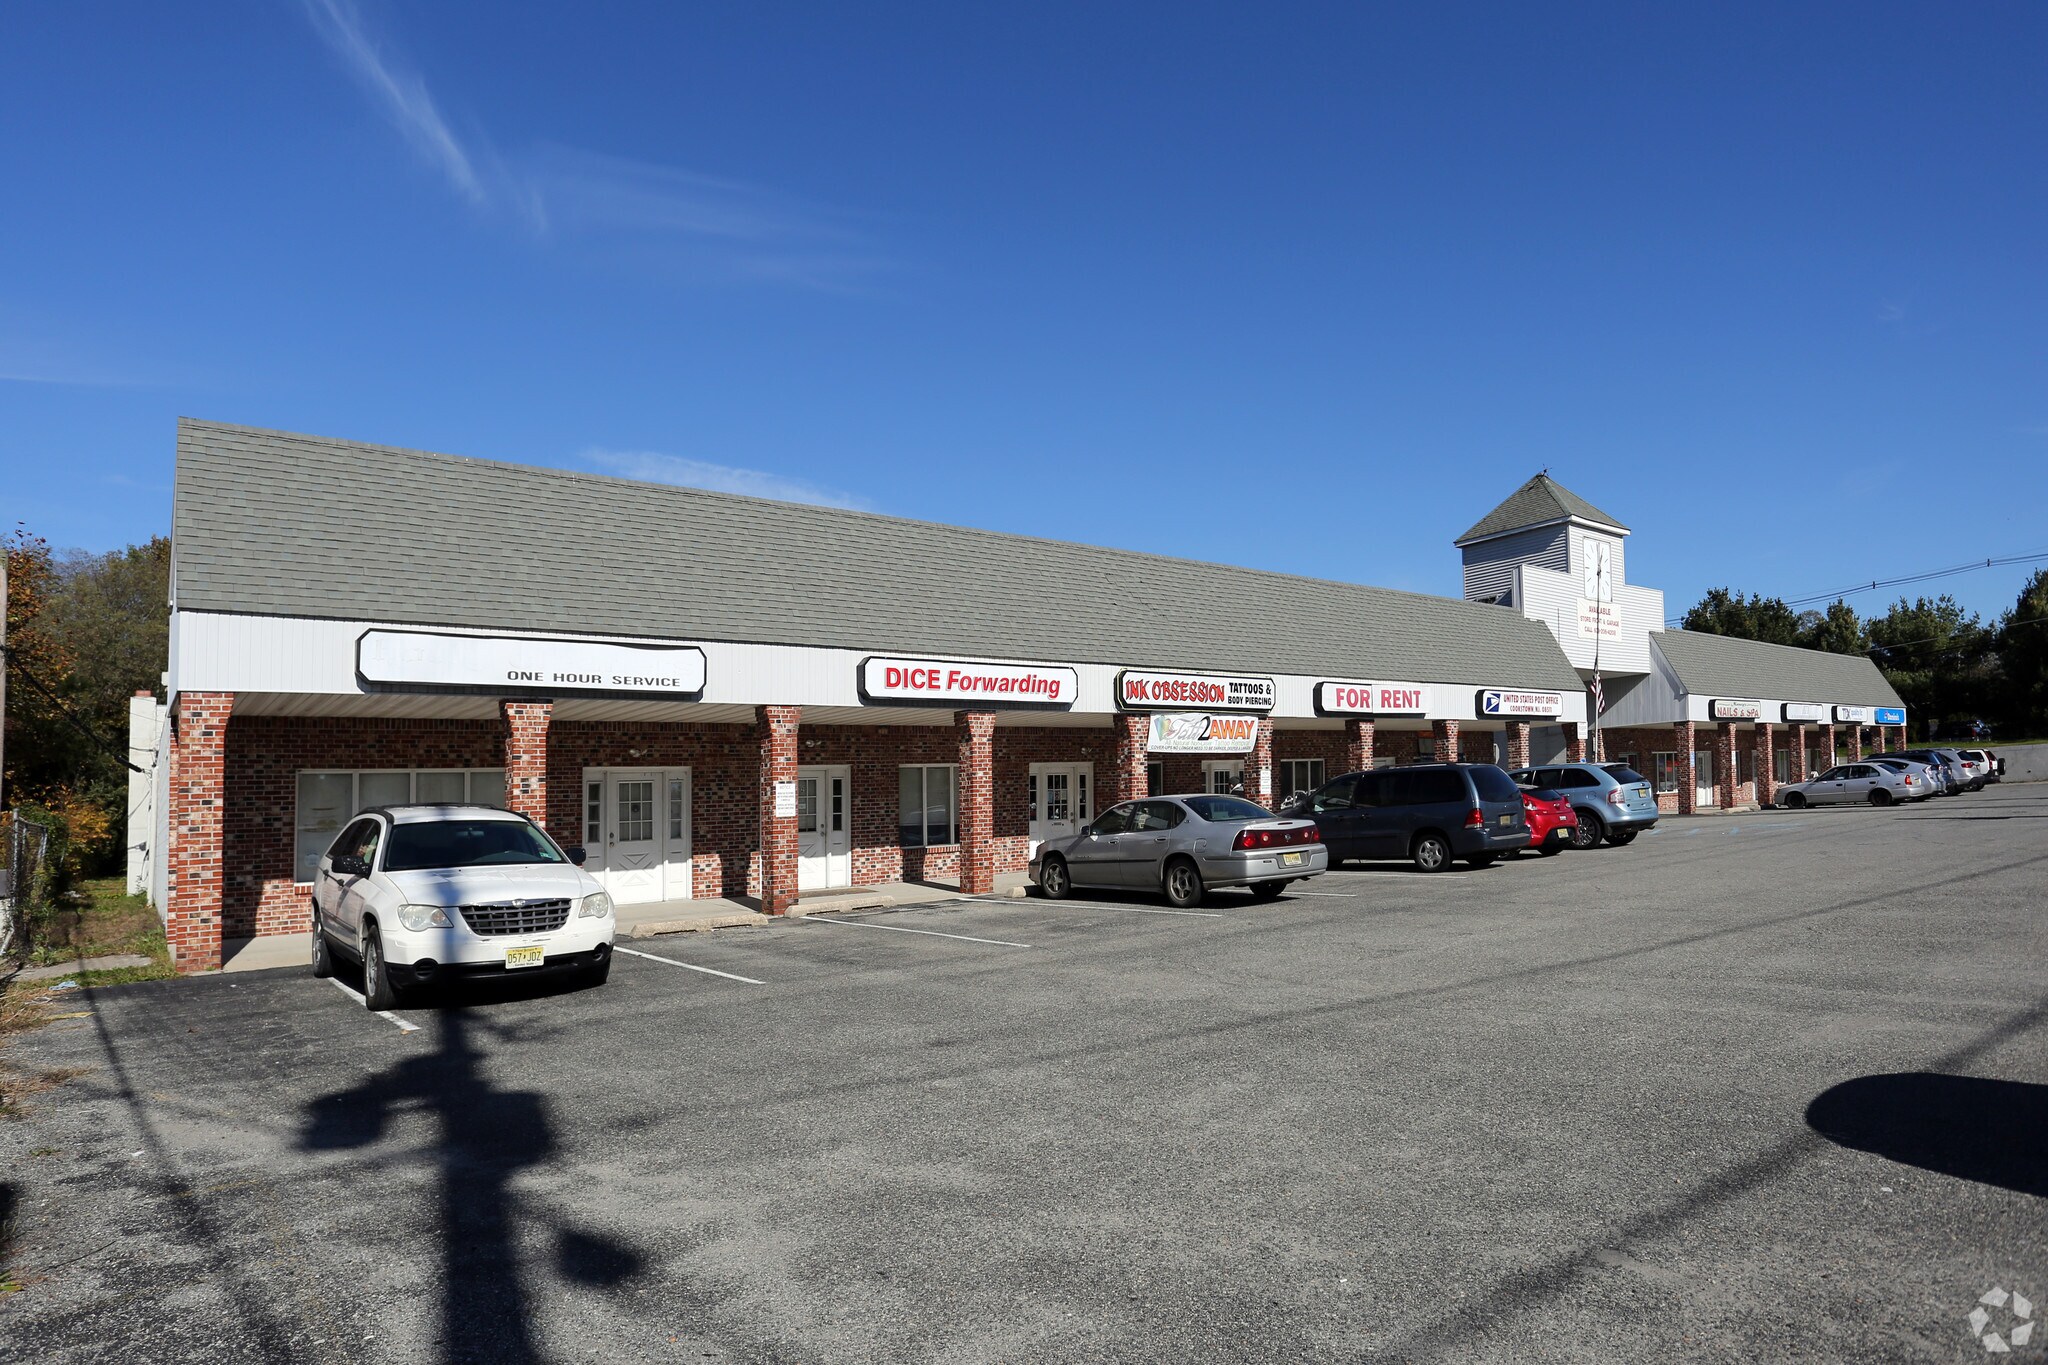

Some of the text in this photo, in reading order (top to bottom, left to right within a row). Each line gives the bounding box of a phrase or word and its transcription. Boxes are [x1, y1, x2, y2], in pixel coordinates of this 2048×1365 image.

[1588, 605, 1611, 616] AVAABLE
[507, 670, 681, 687] ONE HOUR SERVICE
[885, 667, 1061, 699] DICE Forwarding
[1126, 679, 1225, 704] INK OBSESSION
[1228, 682, 1272, 695] TATTOOS &
[1227, 695, 1272, 706] BODY PIERCING
[1336, 688, 1421, 709] FOR RENT
[1503, 694, 1559, 705] UNITED STATES POST OFFICE
[1717, 706, 1759, 717] NAILS & SPA
